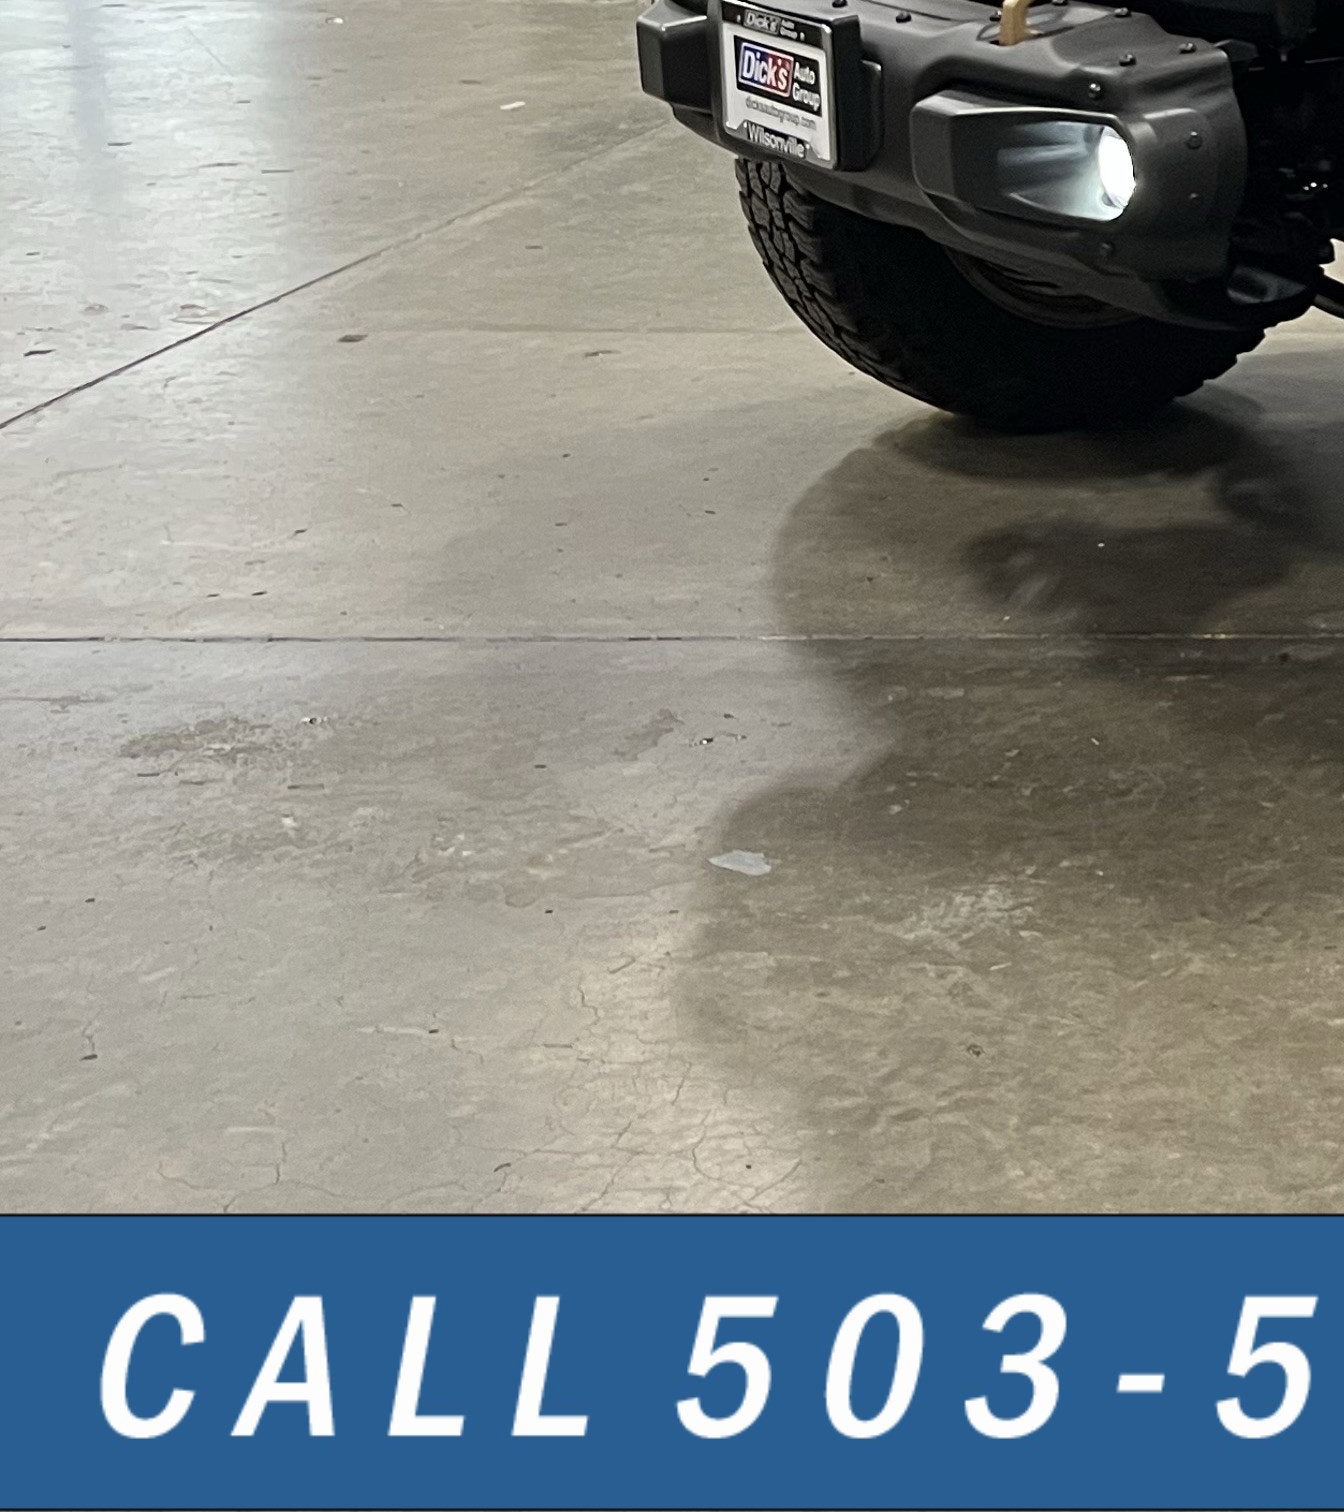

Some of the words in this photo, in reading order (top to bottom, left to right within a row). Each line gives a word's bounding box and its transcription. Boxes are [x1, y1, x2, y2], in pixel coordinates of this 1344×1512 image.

[742, 49, 789, 91] Dick's
[793, 61, 816, 85] Auto
[792, 83, 821, 112] Group
[748, 121, 806, 159] Wilsonville
